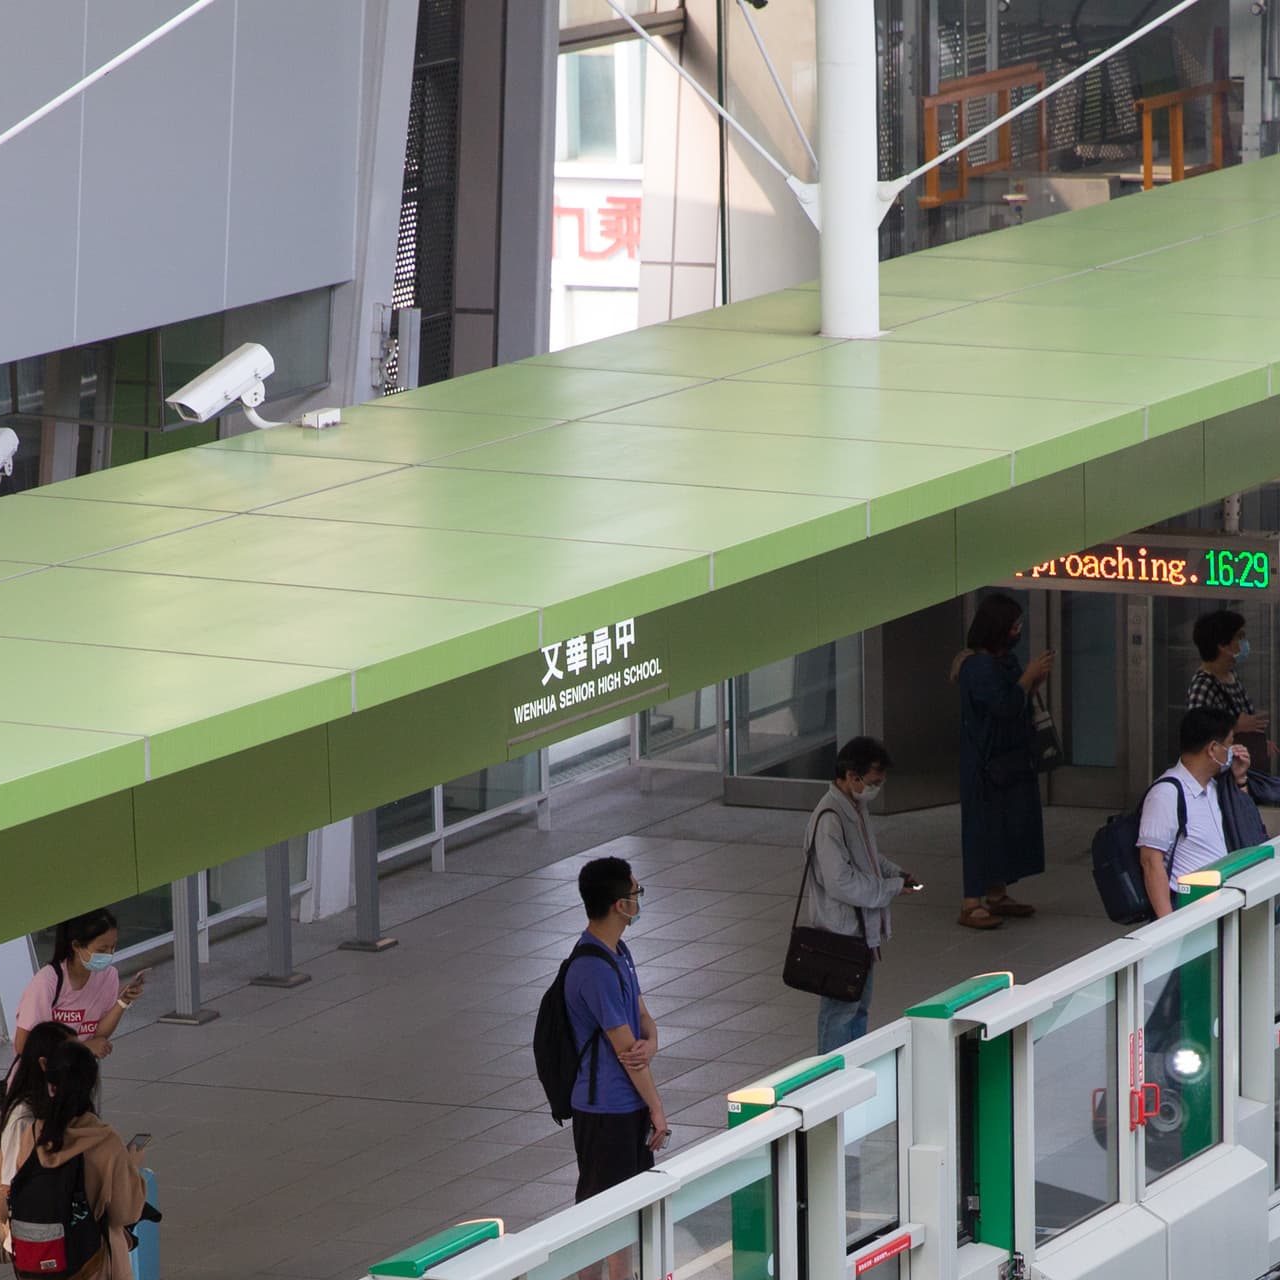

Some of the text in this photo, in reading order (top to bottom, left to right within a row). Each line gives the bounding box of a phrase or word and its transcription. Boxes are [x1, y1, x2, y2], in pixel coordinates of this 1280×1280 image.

[1205, 550, 1269, 588] 16:29
[513, 657, 663, 725] WENHUA SENIOR HIGH SCHOOL
